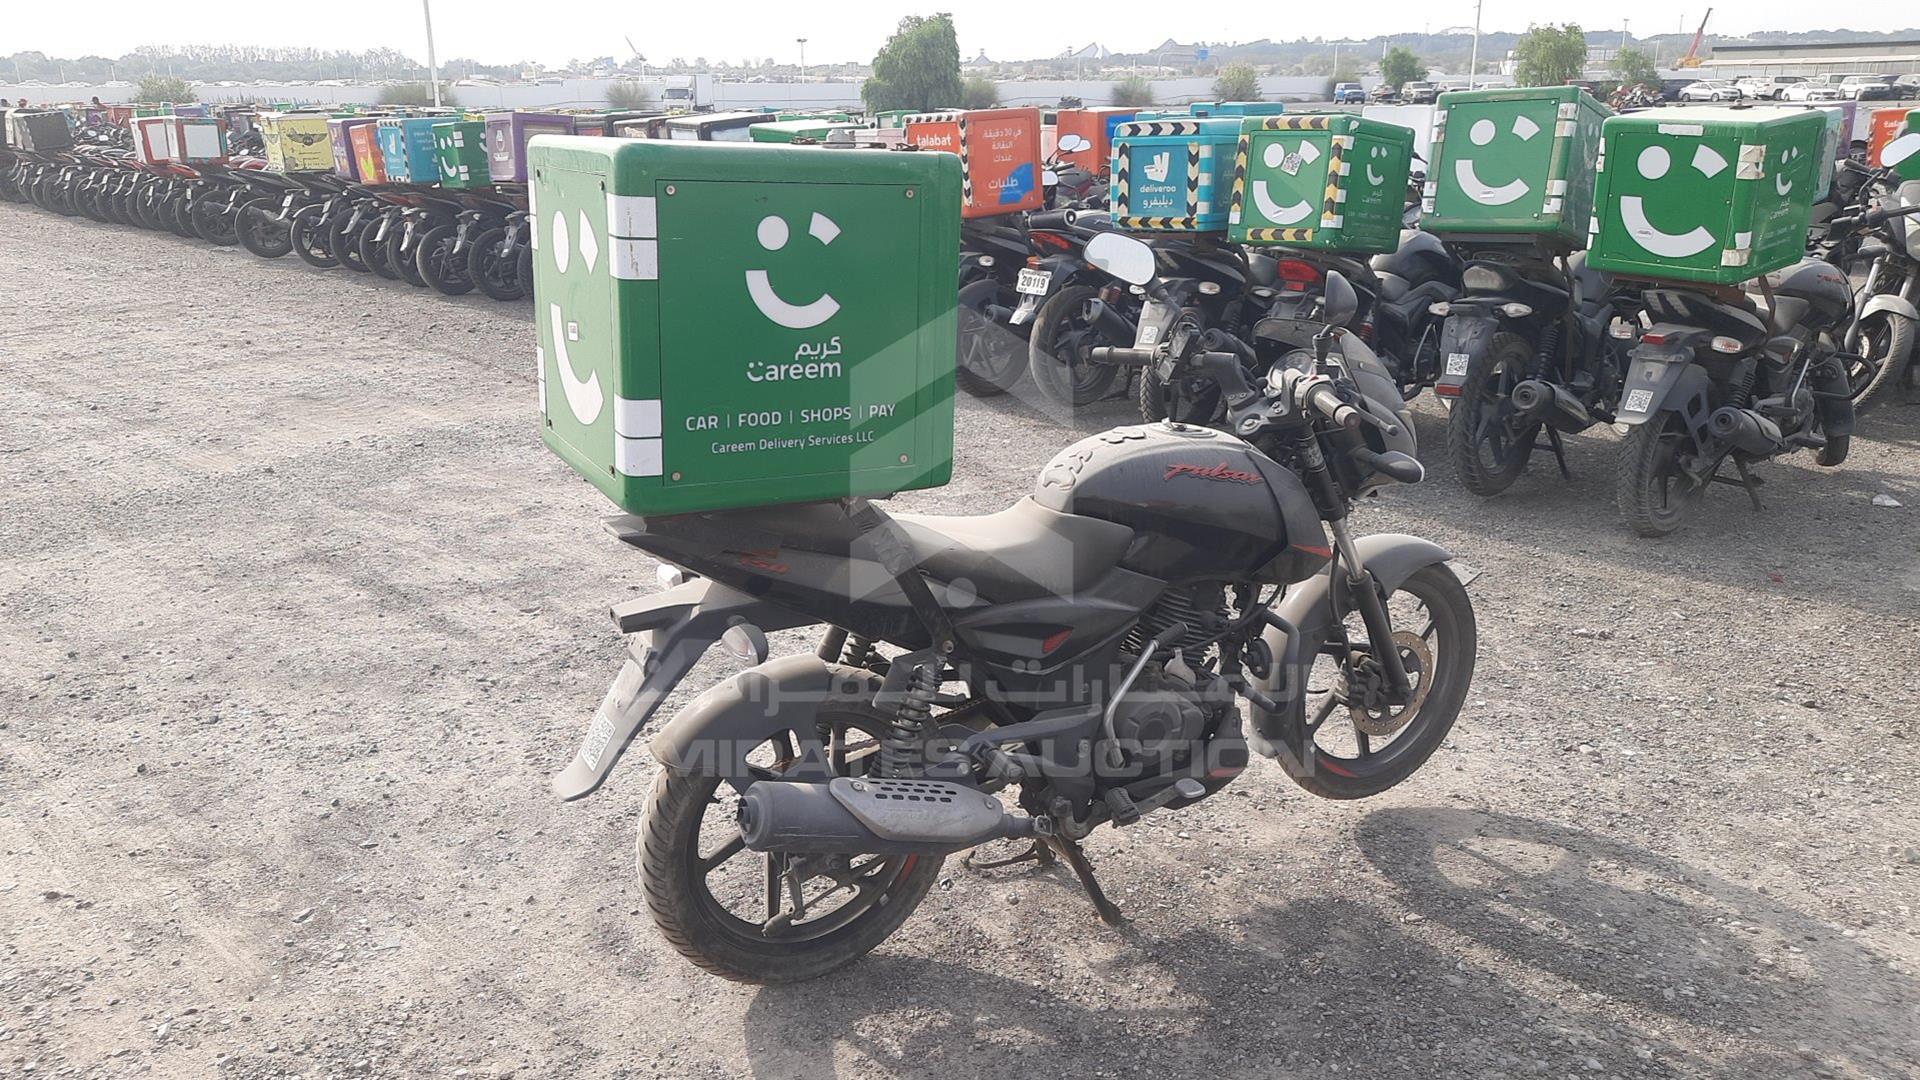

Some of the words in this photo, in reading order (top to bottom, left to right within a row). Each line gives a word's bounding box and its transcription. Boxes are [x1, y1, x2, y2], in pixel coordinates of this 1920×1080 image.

[916, 134, 952, 147] talabat
[988, 176, 1019, 190] طلبات
[1140, 183, 1176, 194] deliveroo
[1021, 275, 1046, 289] 20119
[794, 336, 842, 361] كريم
[746, 360, 842, 382] Careem
[685, 415, 719, 432] CAR
[737, 410, 783, 427] FOOD
[800, 406, 852, 423] SHOPS
[869, 403, 896, 419] PAY
[711, 442, 756, 454] Careem
[759, 437, 805, 453] Delivery
[808, 433, 853, 448] Services
[856, 430, 875, 443] LLC
